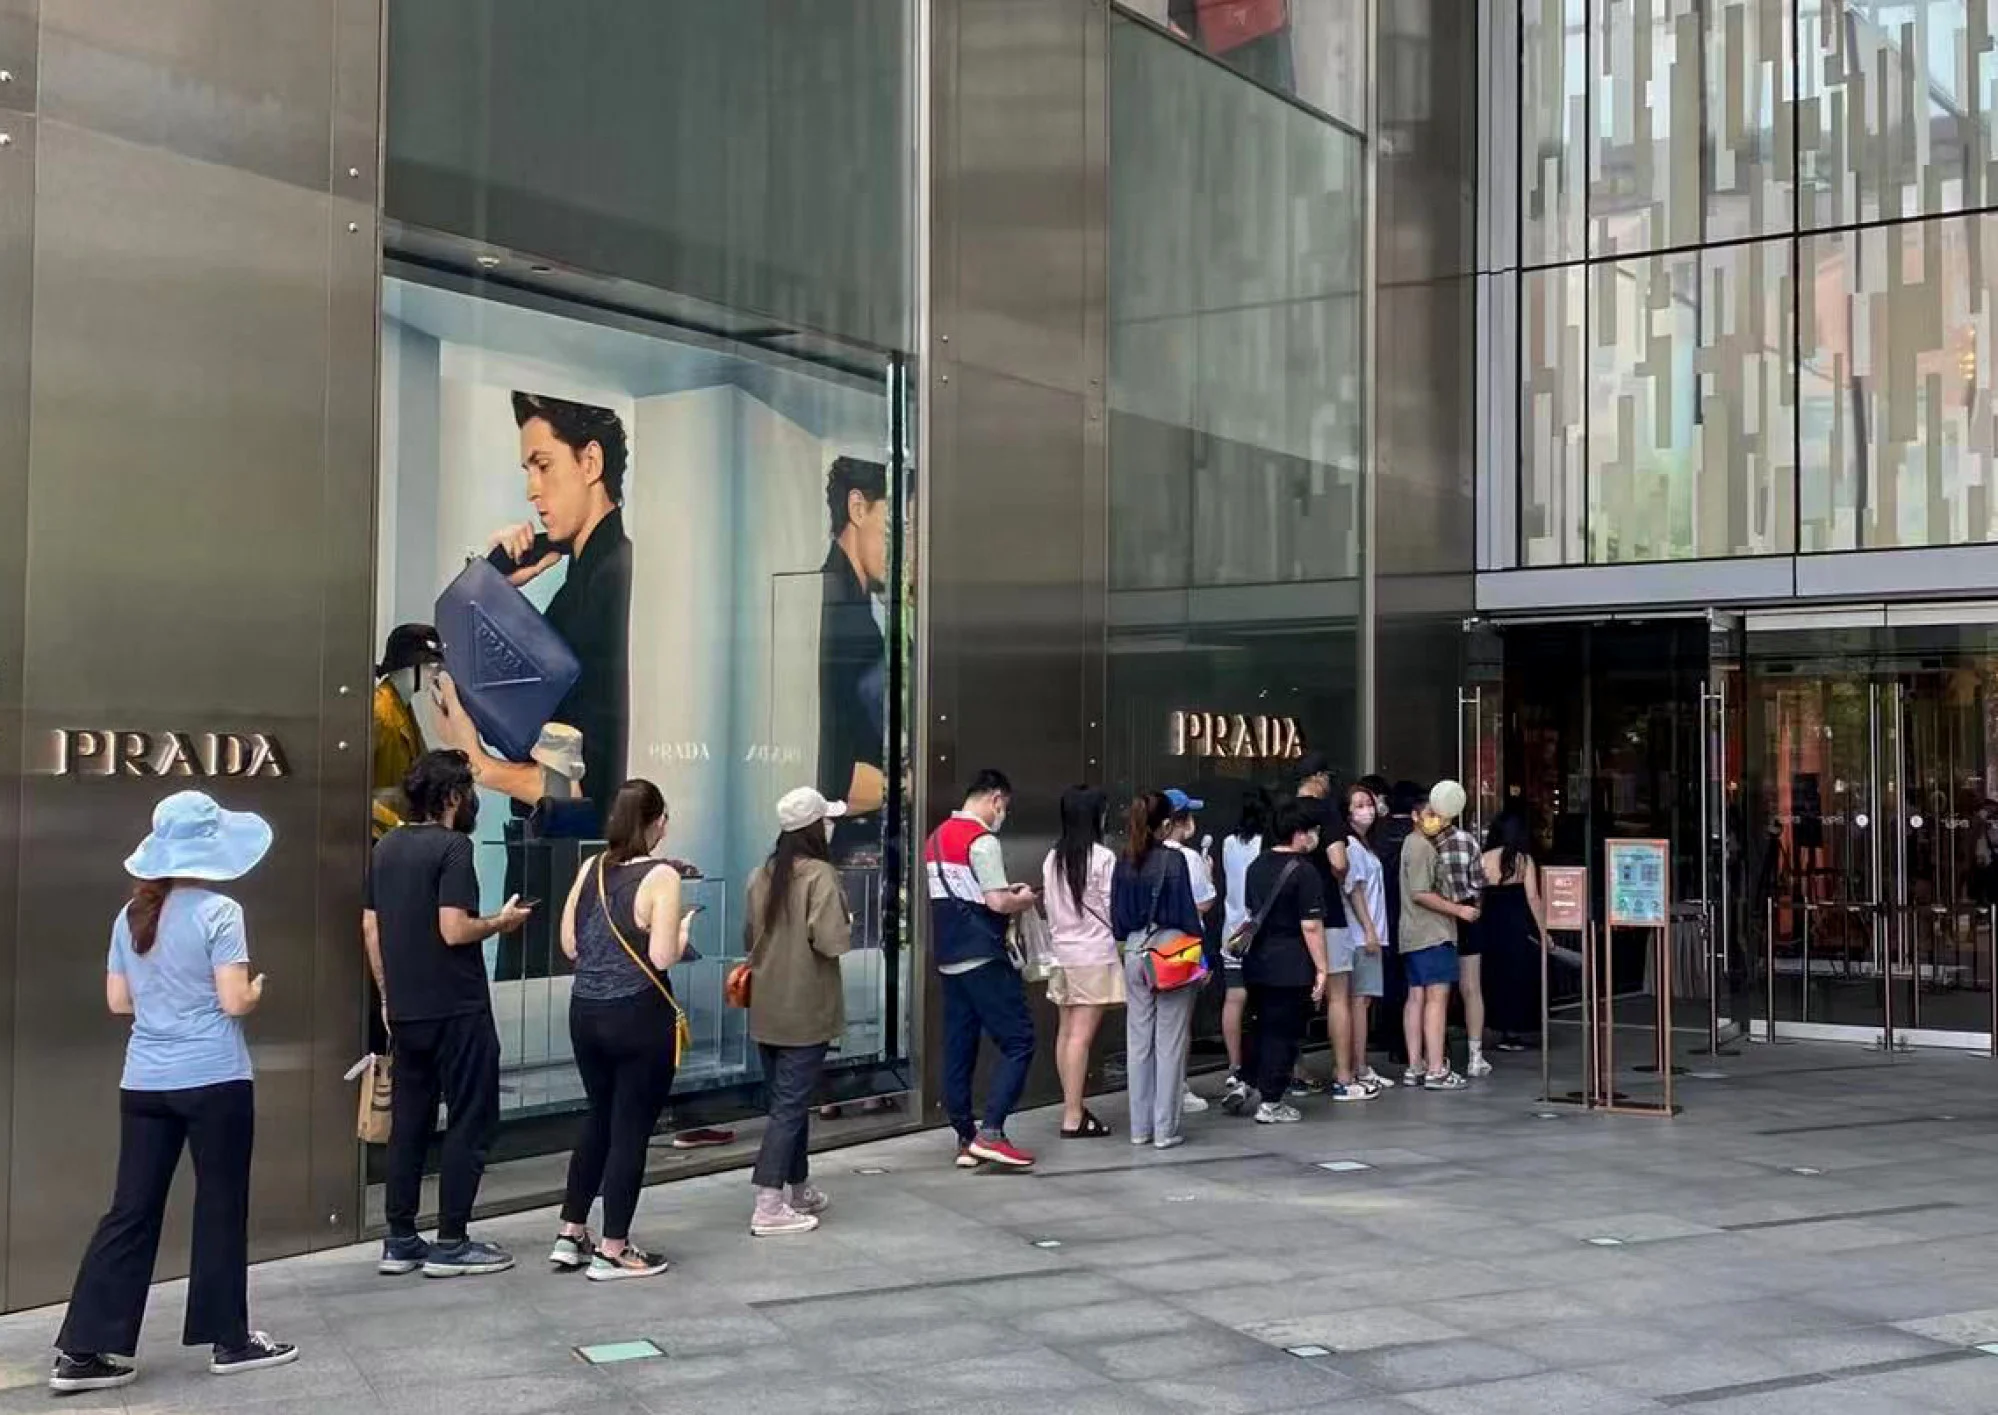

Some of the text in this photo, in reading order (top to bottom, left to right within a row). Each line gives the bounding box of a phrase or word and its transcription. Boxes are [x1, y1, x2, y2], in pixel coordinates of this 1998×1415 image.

[52, 729, 290, 777] PRADA
[650, 741, 710, 761] PRADA
[1170, 711, 1307, 758] PRADA
